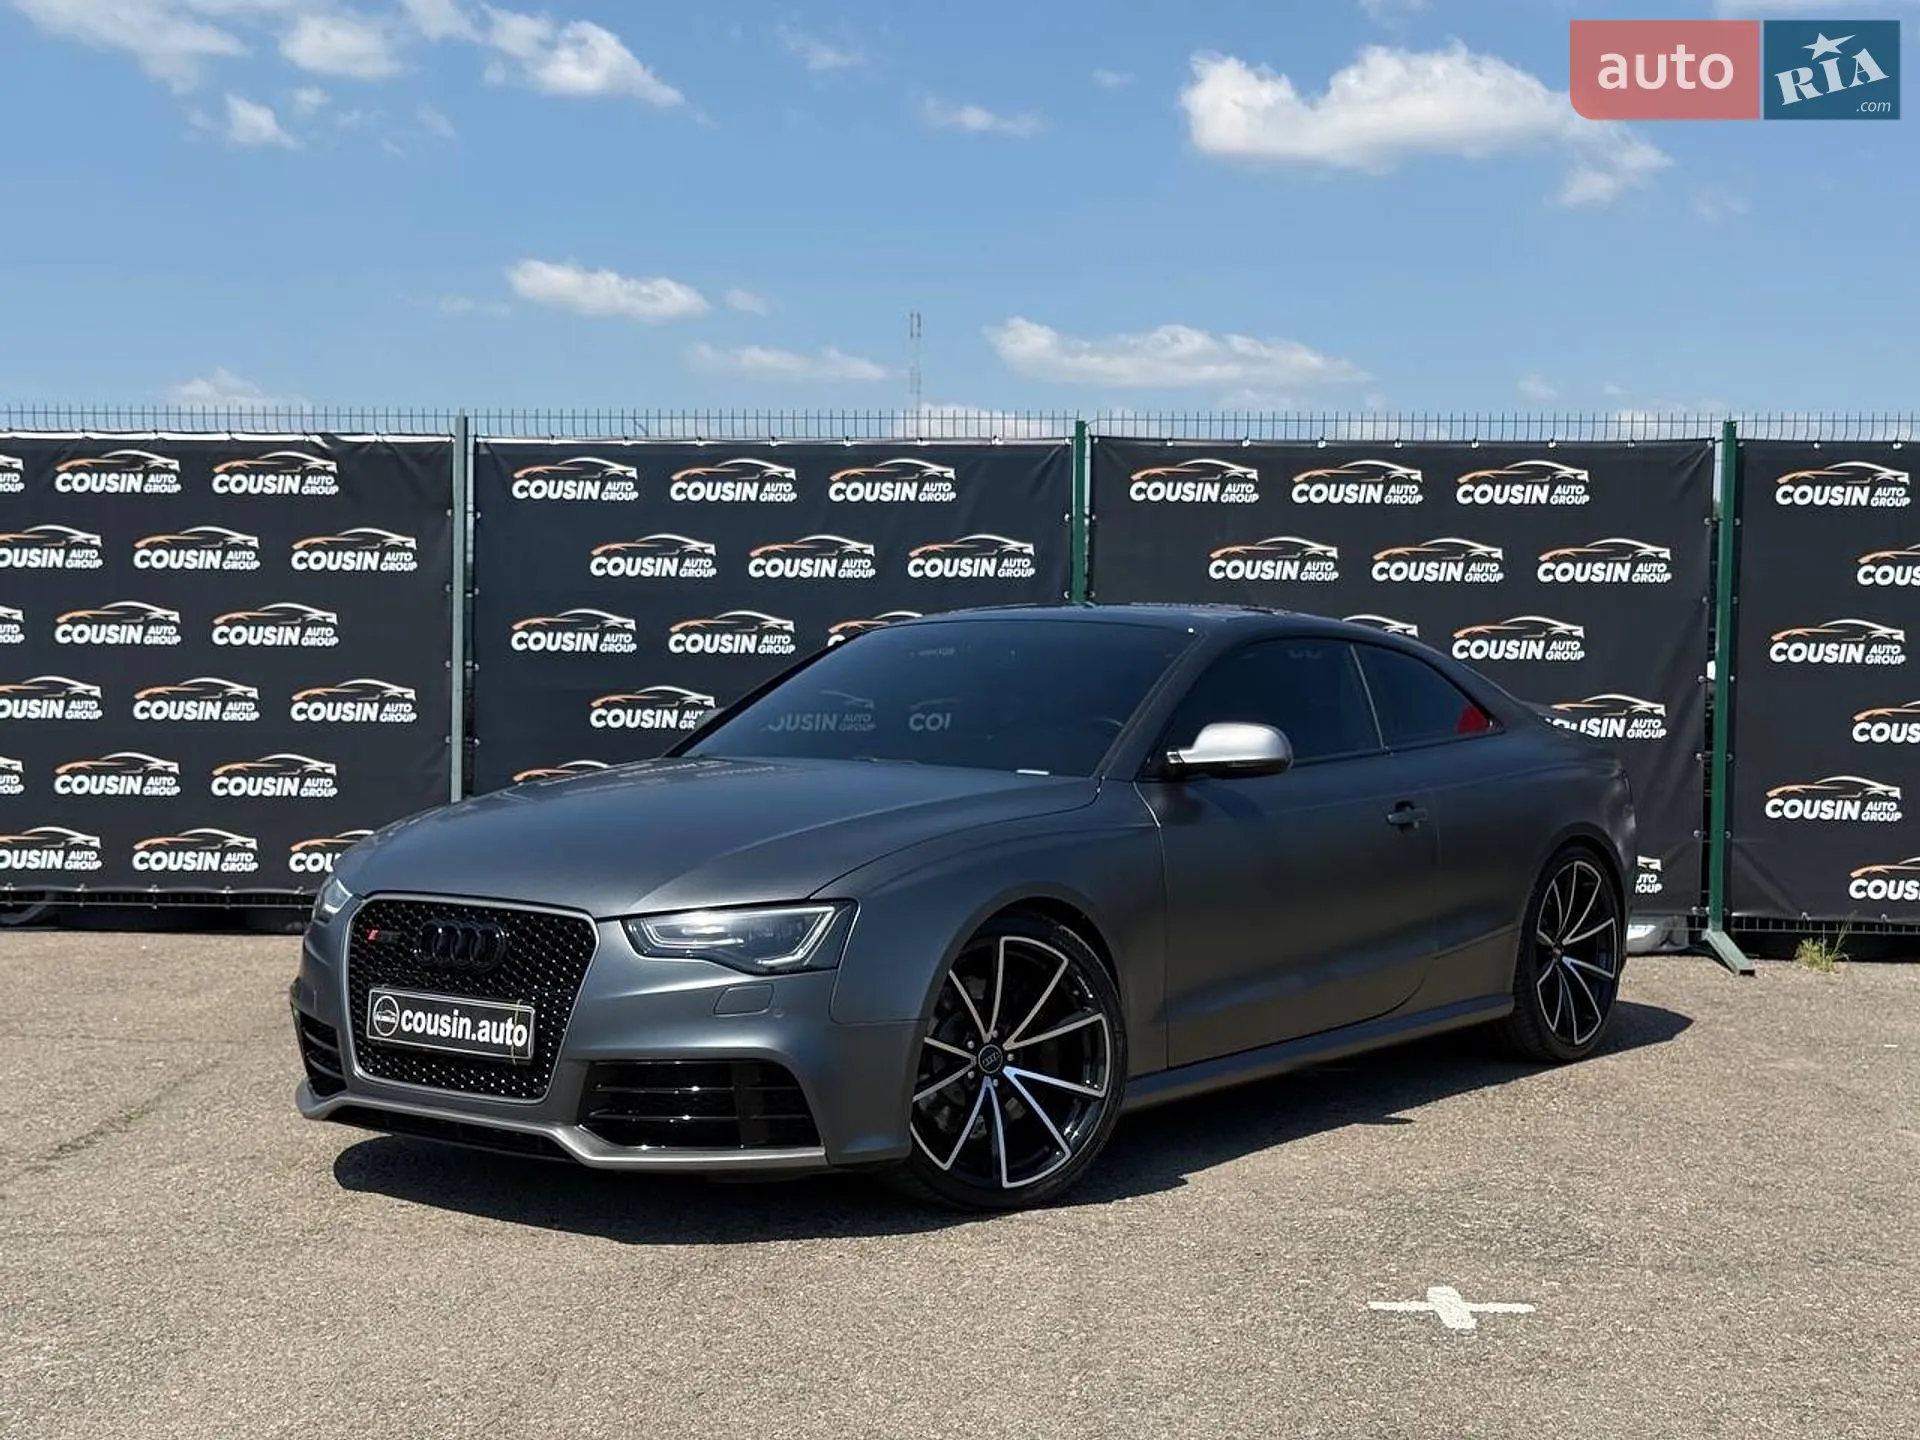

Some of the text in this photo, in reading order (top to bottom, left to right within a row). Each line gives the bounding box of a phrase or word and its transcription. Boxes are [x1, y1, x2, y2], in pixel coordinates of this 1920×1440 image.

[0, 473, 20, 482] UTO
[56, 473, 143, 492] COUSIN
[148, 474, 176, 483] AUTO
[306, 476, 334, 484] AUTO
[143, 483, 181, 493] GROUP
[212, 474, 301, 494] COUSIN
[606, 481, 634, 490] AUTO
[764, 483, 792, 492] AUTO
[923, 483, 951, 492] AUTO
[1225, 483, 1254, 492] AUTO
[301, 485, 339, 494] GROUP
[512, 480, 601, 500] COUSIN
[670, 481, 759, 501] COUSIN
[829, 482, 918, 502] COUSIN
[1130, 482, 1220, 502] COUSIN
[1292, 483, 1384, 503] COUSIN
[1389, 485, 1418, 494] AUTO
[1456, 484, 1550, 504] COUSIN
[1555, 486, 1585, 494] AUTO
[1876, 487, 1906, 496] AUTO
[601, 491, 638, 500] GROUP
[759, 492, 797, 502] GROUP
[918, 492, 956, 502] GROUP
[1220, 493, 1259, 503] GROUP
[1384, 494, 1423, 504] GROUP
[1550, 495, 1590, 504] GROUP
[1776, 485, 1870, 506] COUSIN
[1871, 496, 1910, 506] GROUP
[0, 548, 65, 568] OUSIN
[70, 550, 98, 558] AUTO
[134, 549, 222, 569] COUSIN
[227, 551, 255, 559] AUTO
[385, 552, 413, 561] AUTO
[65, 559, 103, 568] GROUP
[222, 560, 260, 570] GROUP
[292, 551, 380, 570] COUSIN
[684, 558, 712, 567] AUTO
[843, 559, 871, 568] AUTO
[1002, 559, 1030, 568] AUTO
[1305, 561, 1334, 570] AUTO
[380, 561, 418, 571] GROUP
[590, 556, 678, 576] COUSIN
[749, 558, 838, 578] COUSIN
[908, 558, 996, 578] COUSIN
[1209, 560, 1300, 580] COUSIN
[1372, 561, 1464, 581] COUSIN
[1469, 563, 1499, 572] AUTO
[1637, 564, 1667, 573] AUTO
[679, 567, 716, 577] GROUP
[838, 568, 876, 578] GROUP
[998, 568, 1035, 577] GROUP
[1300, 571, 1339, 581] GROUP
[1464, 572, 1504, 582] GROUP
[1538, 562, 1631, 582] COUSIN
[1857, 565, 1920, 586] COUS
[1632, 573, 1672, 582] GROUP
[0, 625, 20, 633] UTO
[55, 624, 143, 644] COUSIN
[148, 626, 176, 634] AUTO
[306, 627, 334, 636] AUTO
[143, 635, 181, 644] GROUP
[212, 626, 300, 646] COUSIN
[301, 636, 338, 646] GROUP
[604, 633, 632, 642] AUTO
[762, 635, 791, 644] AUTO
[512, 631, 599, 652] COUSIN
[669, 634, 757, 653] COUSIN
[1550, 641, 1580, 650] AUTO
[600, 642, 637, 652] GROUP
[758, 644, 795, 654] GROUP
[1452, 639, 1545, 660] COUSIN
[1871, 644, 1901, 653] AUTO
[1545, 650, 1584, 660] GROUP
[1770, 642, 1865, 663] COUSIN
[1865, 654, 1906, 664] GROUP
[0, 699, 65, 718] OUSIN
[70, 700, 98, 709] AUTO
[227, 702, 255, 711] AUTO
[384, 703, 412, 712] AUTO
[65, 710, 102, 719] GROUP
[133, 700, 222, 720] COUSIN
[290, 702, 379, 722] COUSIN
[222, 711, 260, 721] GROUP
[379, 712, 417, 722] GROUP
[590, 708, 678, 728] COUSIN
[1632, 718, 1662, 727] AUTO
[1626, 728, 1666, 738] GROUP
[1852, 722, 1920, 743] COUS
[0, 775, 19, 784] UTO
[54, 775, 142, 794] COUSIN
[148, 776, 176, 785] AUTO
[305, 778, 333, 787] AUTO
[143, 786, 180, 796] GROUP
[212, 776, 300, 796] COUSIN
[300, 787, 338, 797] GROUP
[1766, 798, 1861, 820] COUSIN
[1867, 800, 1897, 810] AUTO
[1862, 810, 1902, 821] GROUP
[0, 849, 64, 869] OUSIN
[69, 851, 97, 860] AUTO
[226, 853, 254, 861] AUTO
[64, 860, 102, 870] GROUP
[132, 851, 220, 871] COUSIN
[221, 862, 258, 872] GROUP
[1849, 879, 1920, 900] COUS
[400, 1008, 528, 1047] cousin.auto
